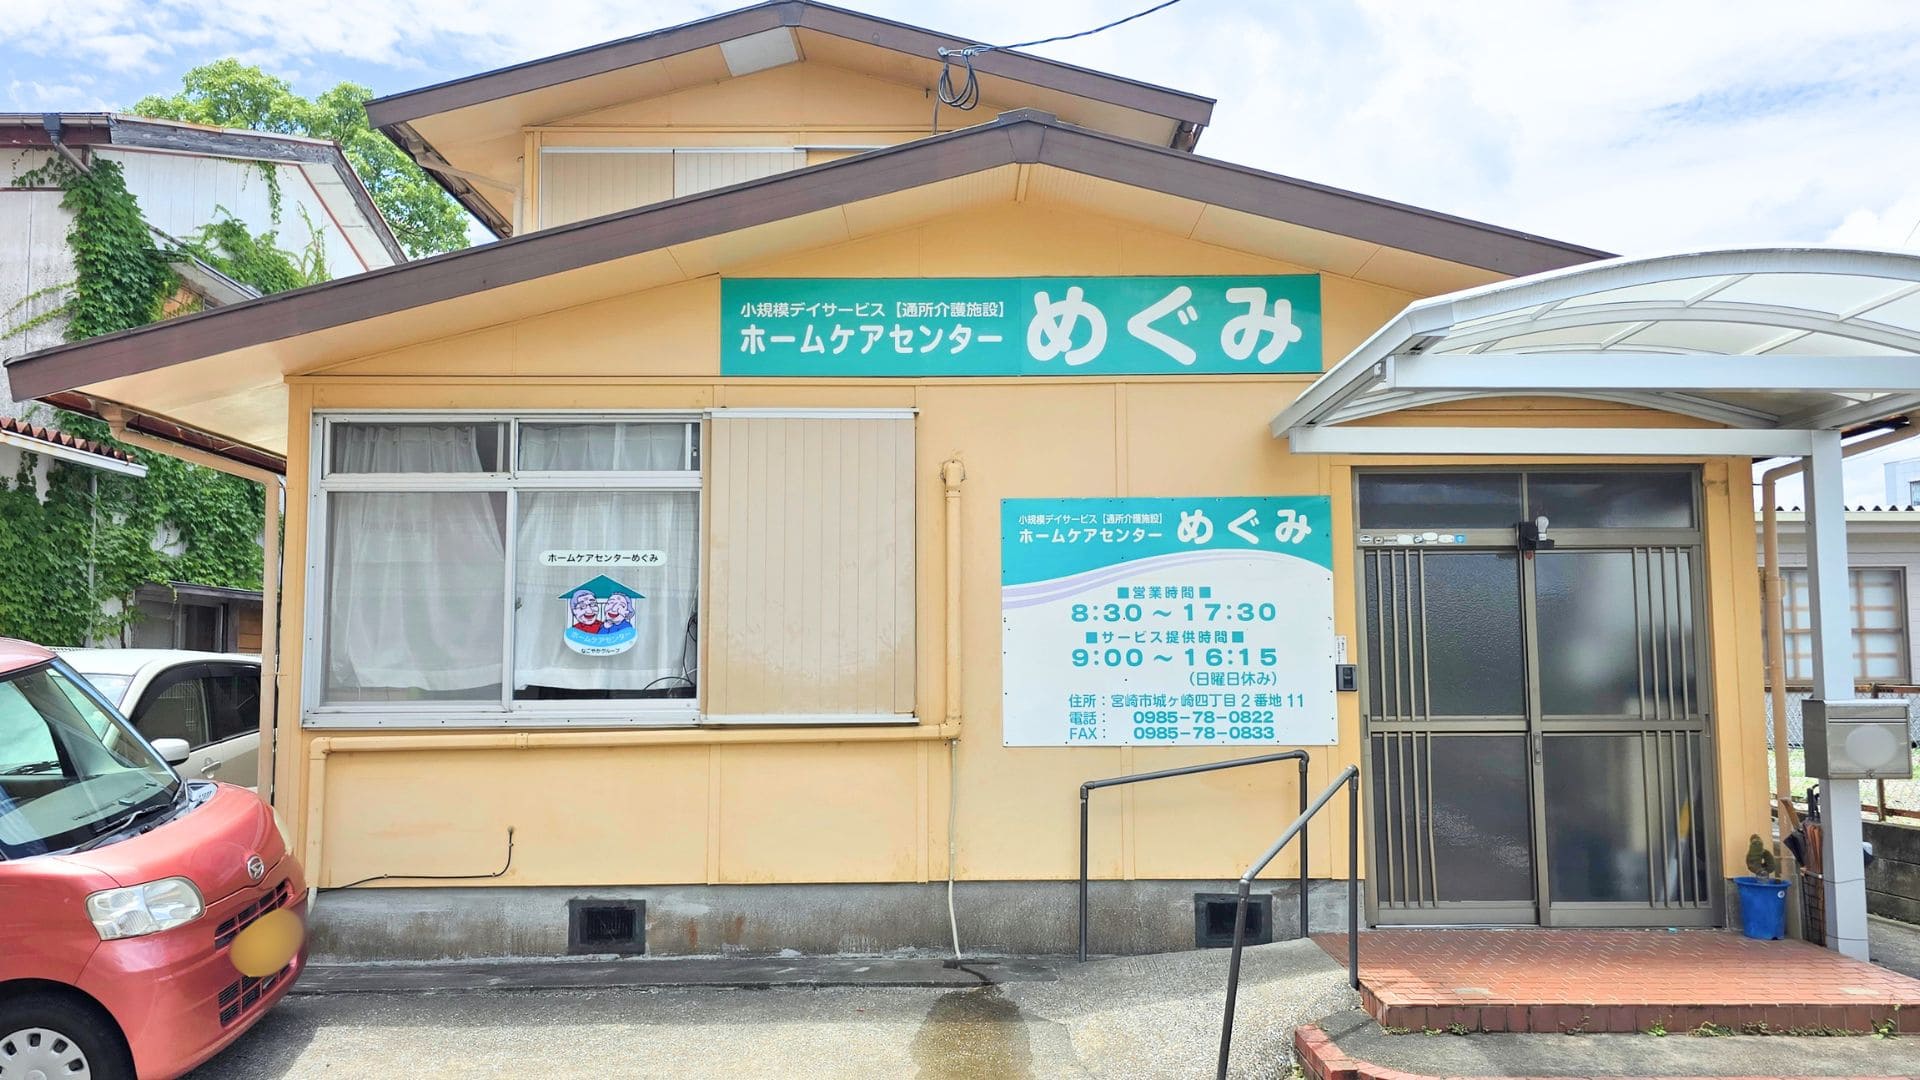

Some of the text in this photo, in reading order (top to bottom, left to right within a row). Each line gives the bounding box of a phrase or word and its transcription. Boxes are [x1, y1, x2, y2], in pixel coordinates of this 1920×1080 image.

[1026, 286, 1302, 366] めぐみ
[740, 323, 1003, 355] ホームケアセンター
[1177, 509, 1312, 545] めぐみ
[1019, 528, 1162, 543] ホームケアセンター
[547, 553, 659, 563] ホームケアセンターめぐみ
[1132, 585, 1195, 600] 営業時間
[1101, 630, 1228, 645] サービス提供時間
[1132, 710, 1275, 725] 0985-78-0822
[1132, 725, 1276, 740] 0985-78-0833
